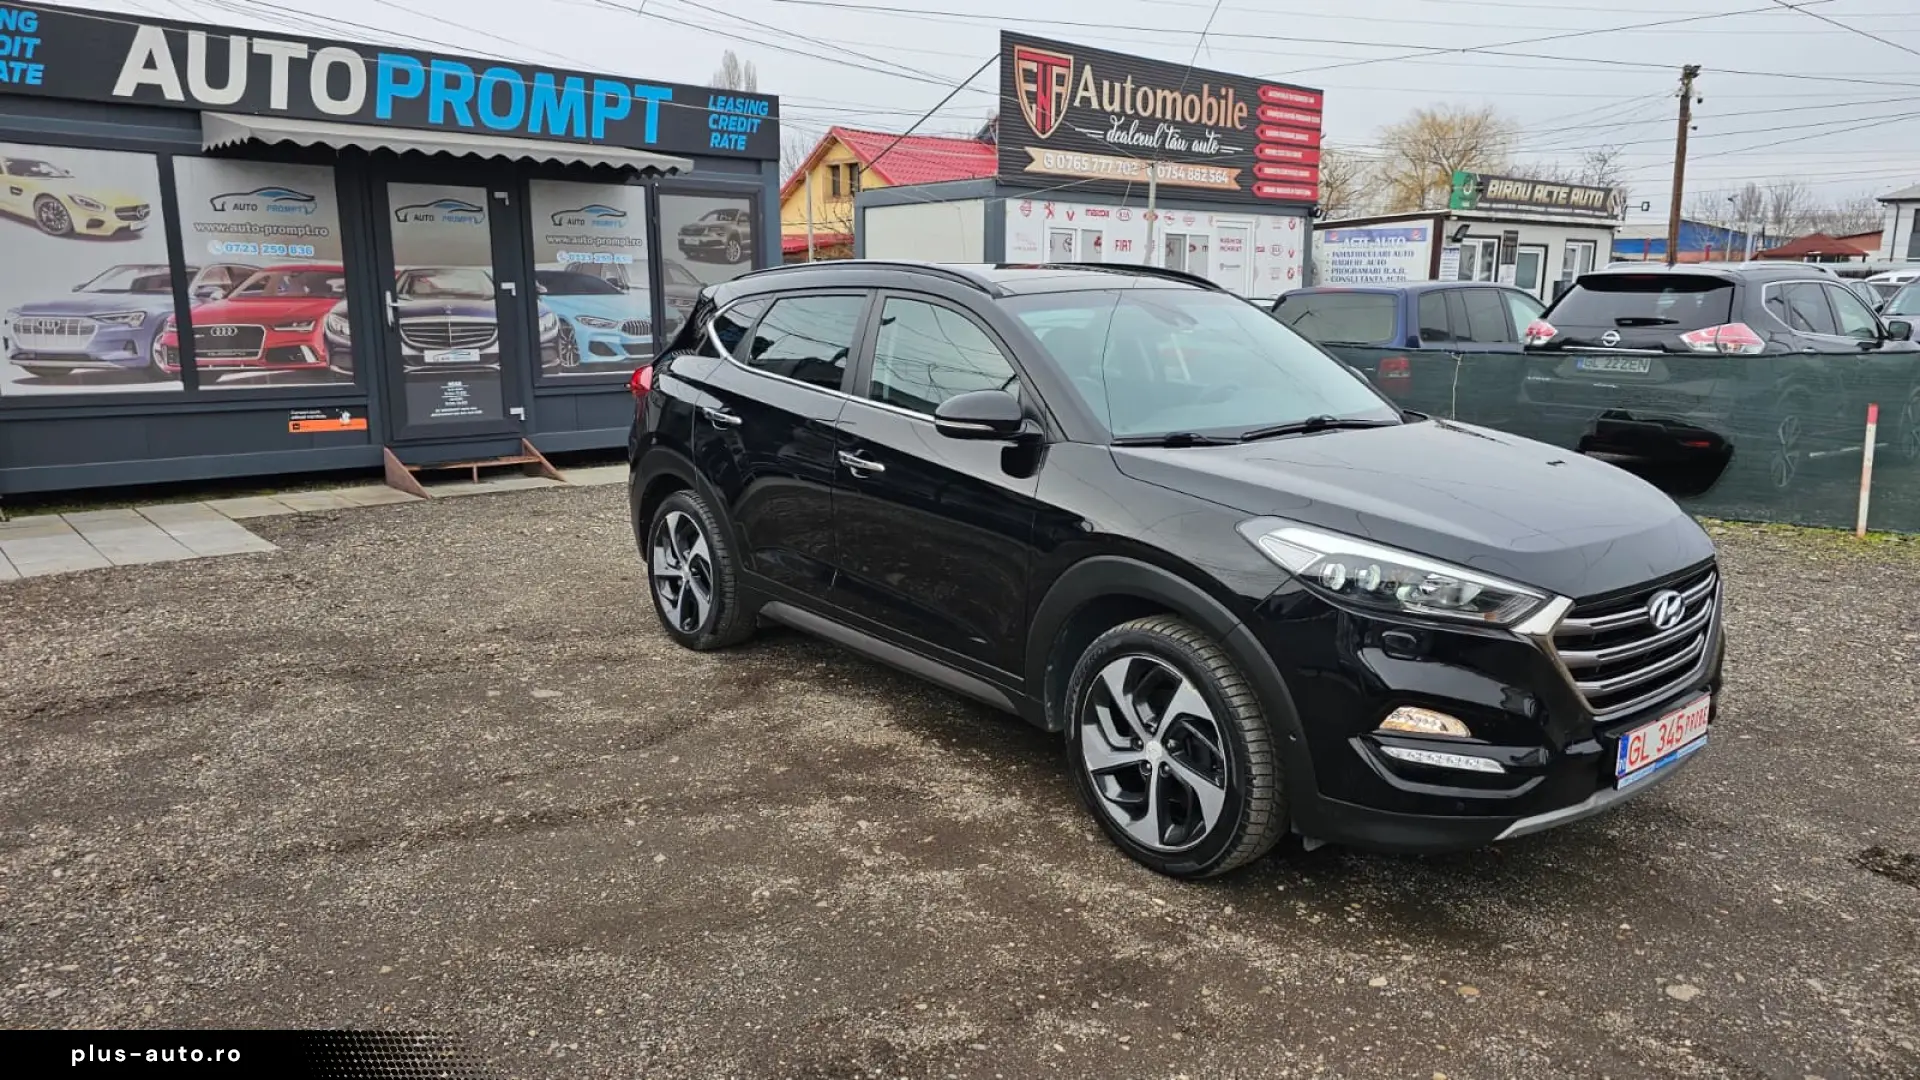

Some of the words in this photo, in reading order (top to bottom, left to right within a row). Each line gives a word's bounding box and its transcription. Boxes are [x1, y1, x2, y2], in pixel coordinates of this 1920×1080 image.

[708, 95, 768, 116] LEASING
[1073, 64, 1248, 130] Automobile
[709, 114, 762, 134] CREDIT
[710, 132, 747, 150] RATE
[1192, 129, 1221, 154] auto
[1056, 151, 1088, 171] 0765
[1091, 154, 1114, 173] 777
[1157, 165, 1185, 180] 0754
[1487, 179, 1532, 201] BIROU
[1533, 184, 1570, 204] ACTE
[1570, 187, 1605, 208] AUTO
[232, 203, 258, 212] AUTO
[413, 214, 435, 222] AUTO
[193, 222, 329, 237] www.auto-prompt.ro
[224, 243, 258, 254] 0723
[263, 244, 286, 255] 259
[1115, 239, 1132, 252] FIAT
[1629, 732, 1649, 766] GL
[1656, 712, 1684, 752] 345
